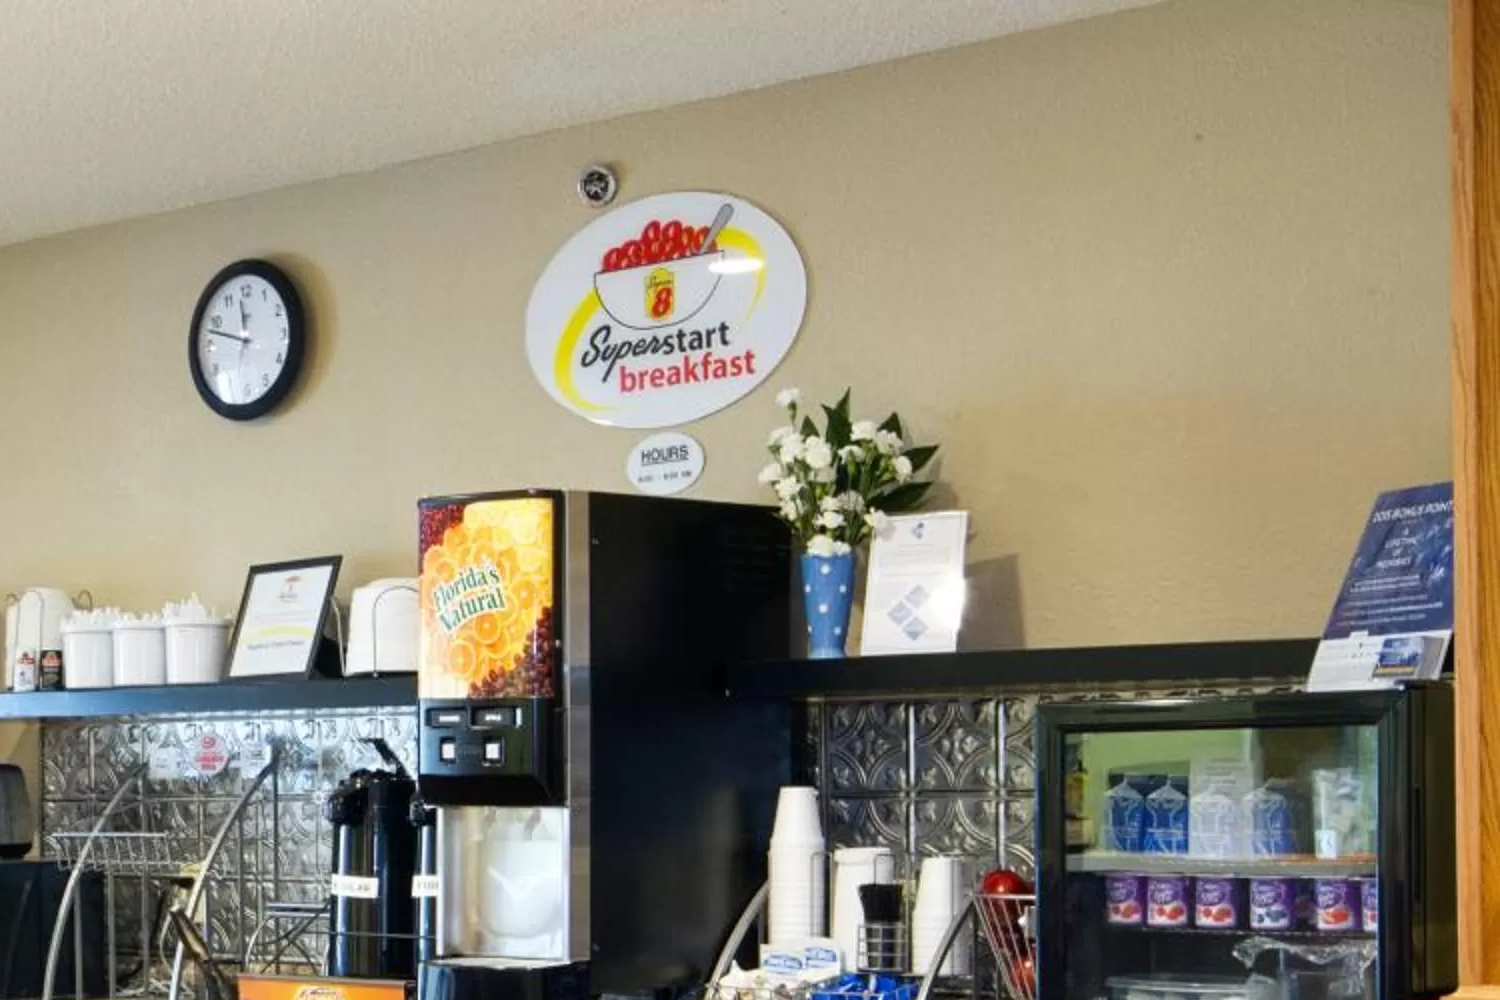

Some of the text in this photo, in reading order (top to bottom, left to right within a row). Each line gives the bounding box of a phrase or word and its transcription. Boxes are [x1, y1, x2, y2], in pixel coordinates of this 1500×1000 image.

[652, 287, 672, 318] 8
[581, 322, 730, 383] Superstart
[619, 349, 757, 393] breakfast
[641, 444, 690, 464] HOURS
[433, 566, 501, 611] Florida's
[440, 587, 506, 631] Natural
